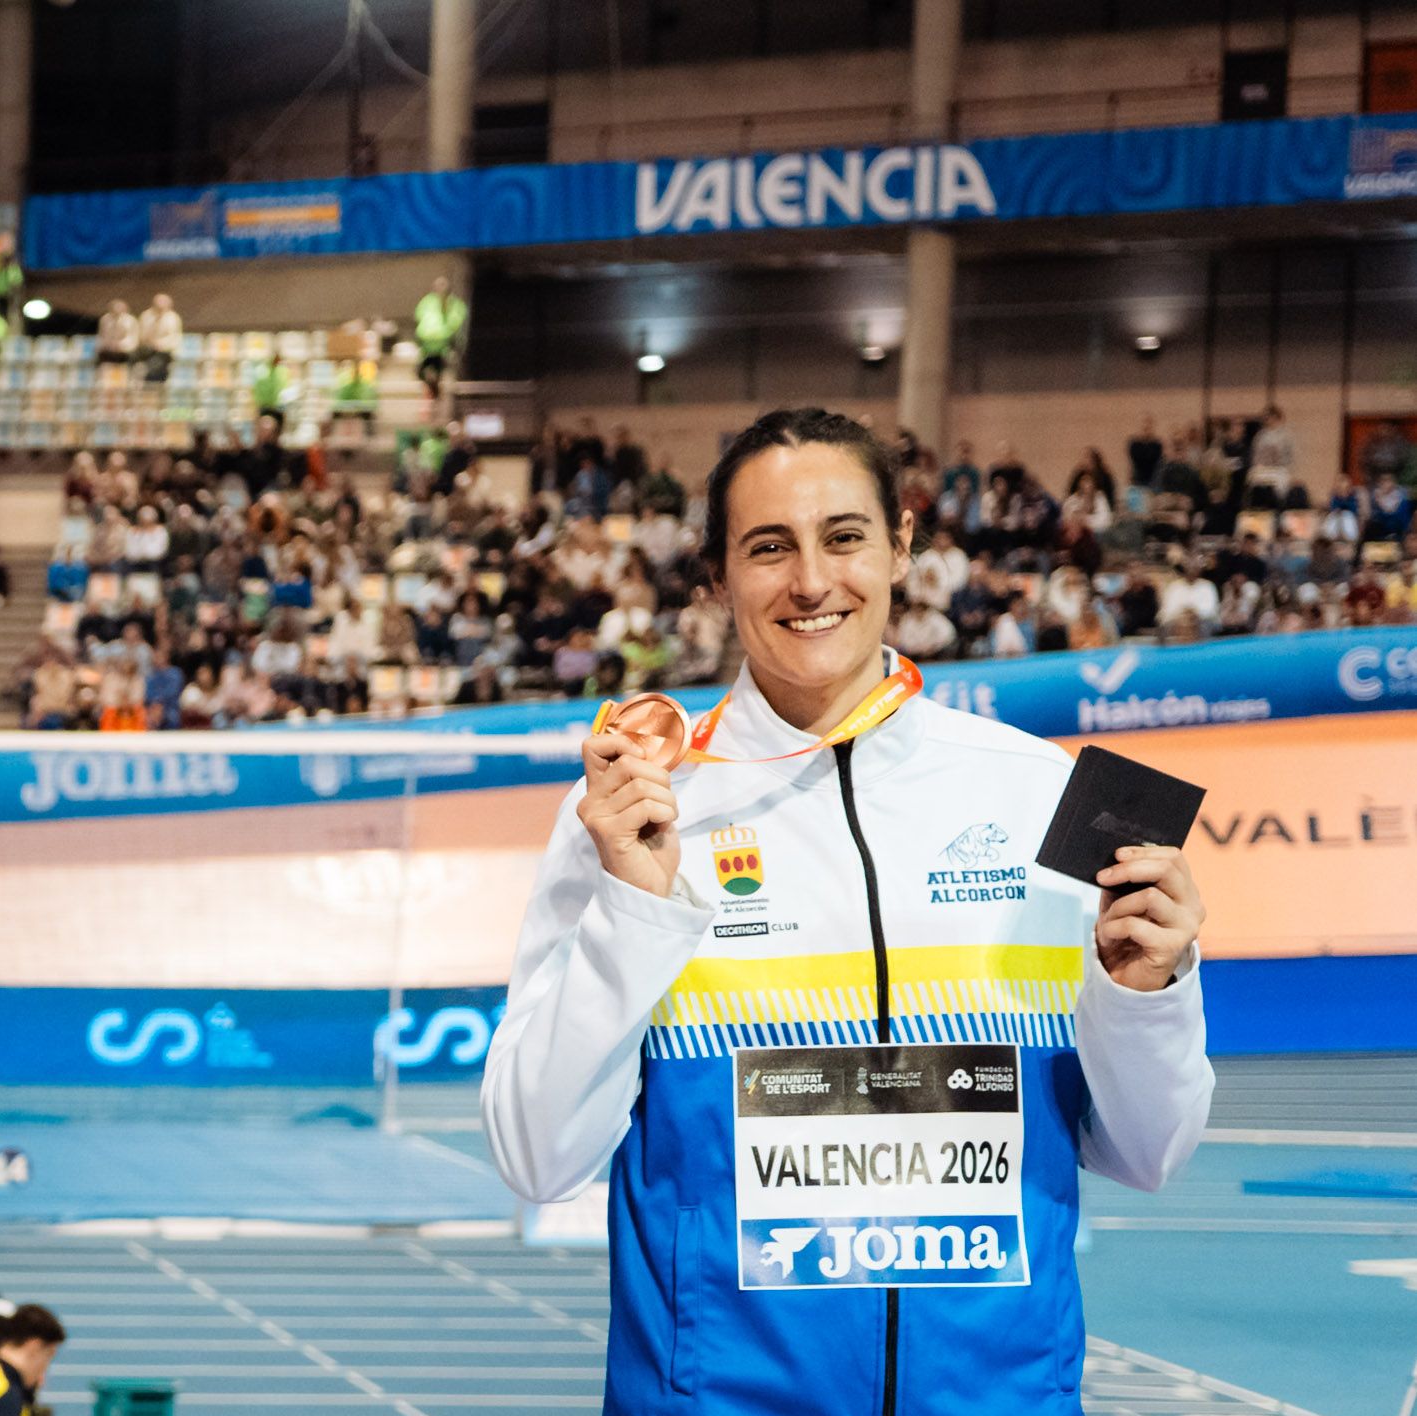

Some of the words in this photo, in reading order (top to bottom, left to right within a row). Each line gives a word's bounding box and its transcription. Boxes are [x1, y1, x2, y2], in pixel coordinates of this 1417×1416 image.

[635, 143, 998, 234] VALENCIA
[20, 751, 239, 812] Joma
[926, 866, 1026, 885] ATLETISMO
[930, 880, 1027, 904] ALCORCÓN
[715, 923, 767, 937] DECATHLON
[771, 921, 799, 932] CLUB
[761, 1073, 824, 1085] COMUNITAT
[870, 1071, 923, 1081] GENERALITAT
[871, 1079, 922, 1089] VALENCIANA
[975, 1074, 1014, 1083] TRINIDAD
[766, 1085, 781, 1095] DE
[782, 1083, 832, 1094] L'ESPORT
[975, 1082, 1014, 1092] ALFONSO
[751, 1142, 933, 1188] VALENCIA
[940, 1141, 1010, 1185] 2026
[818, 1225, 1008, 1279] Joma
